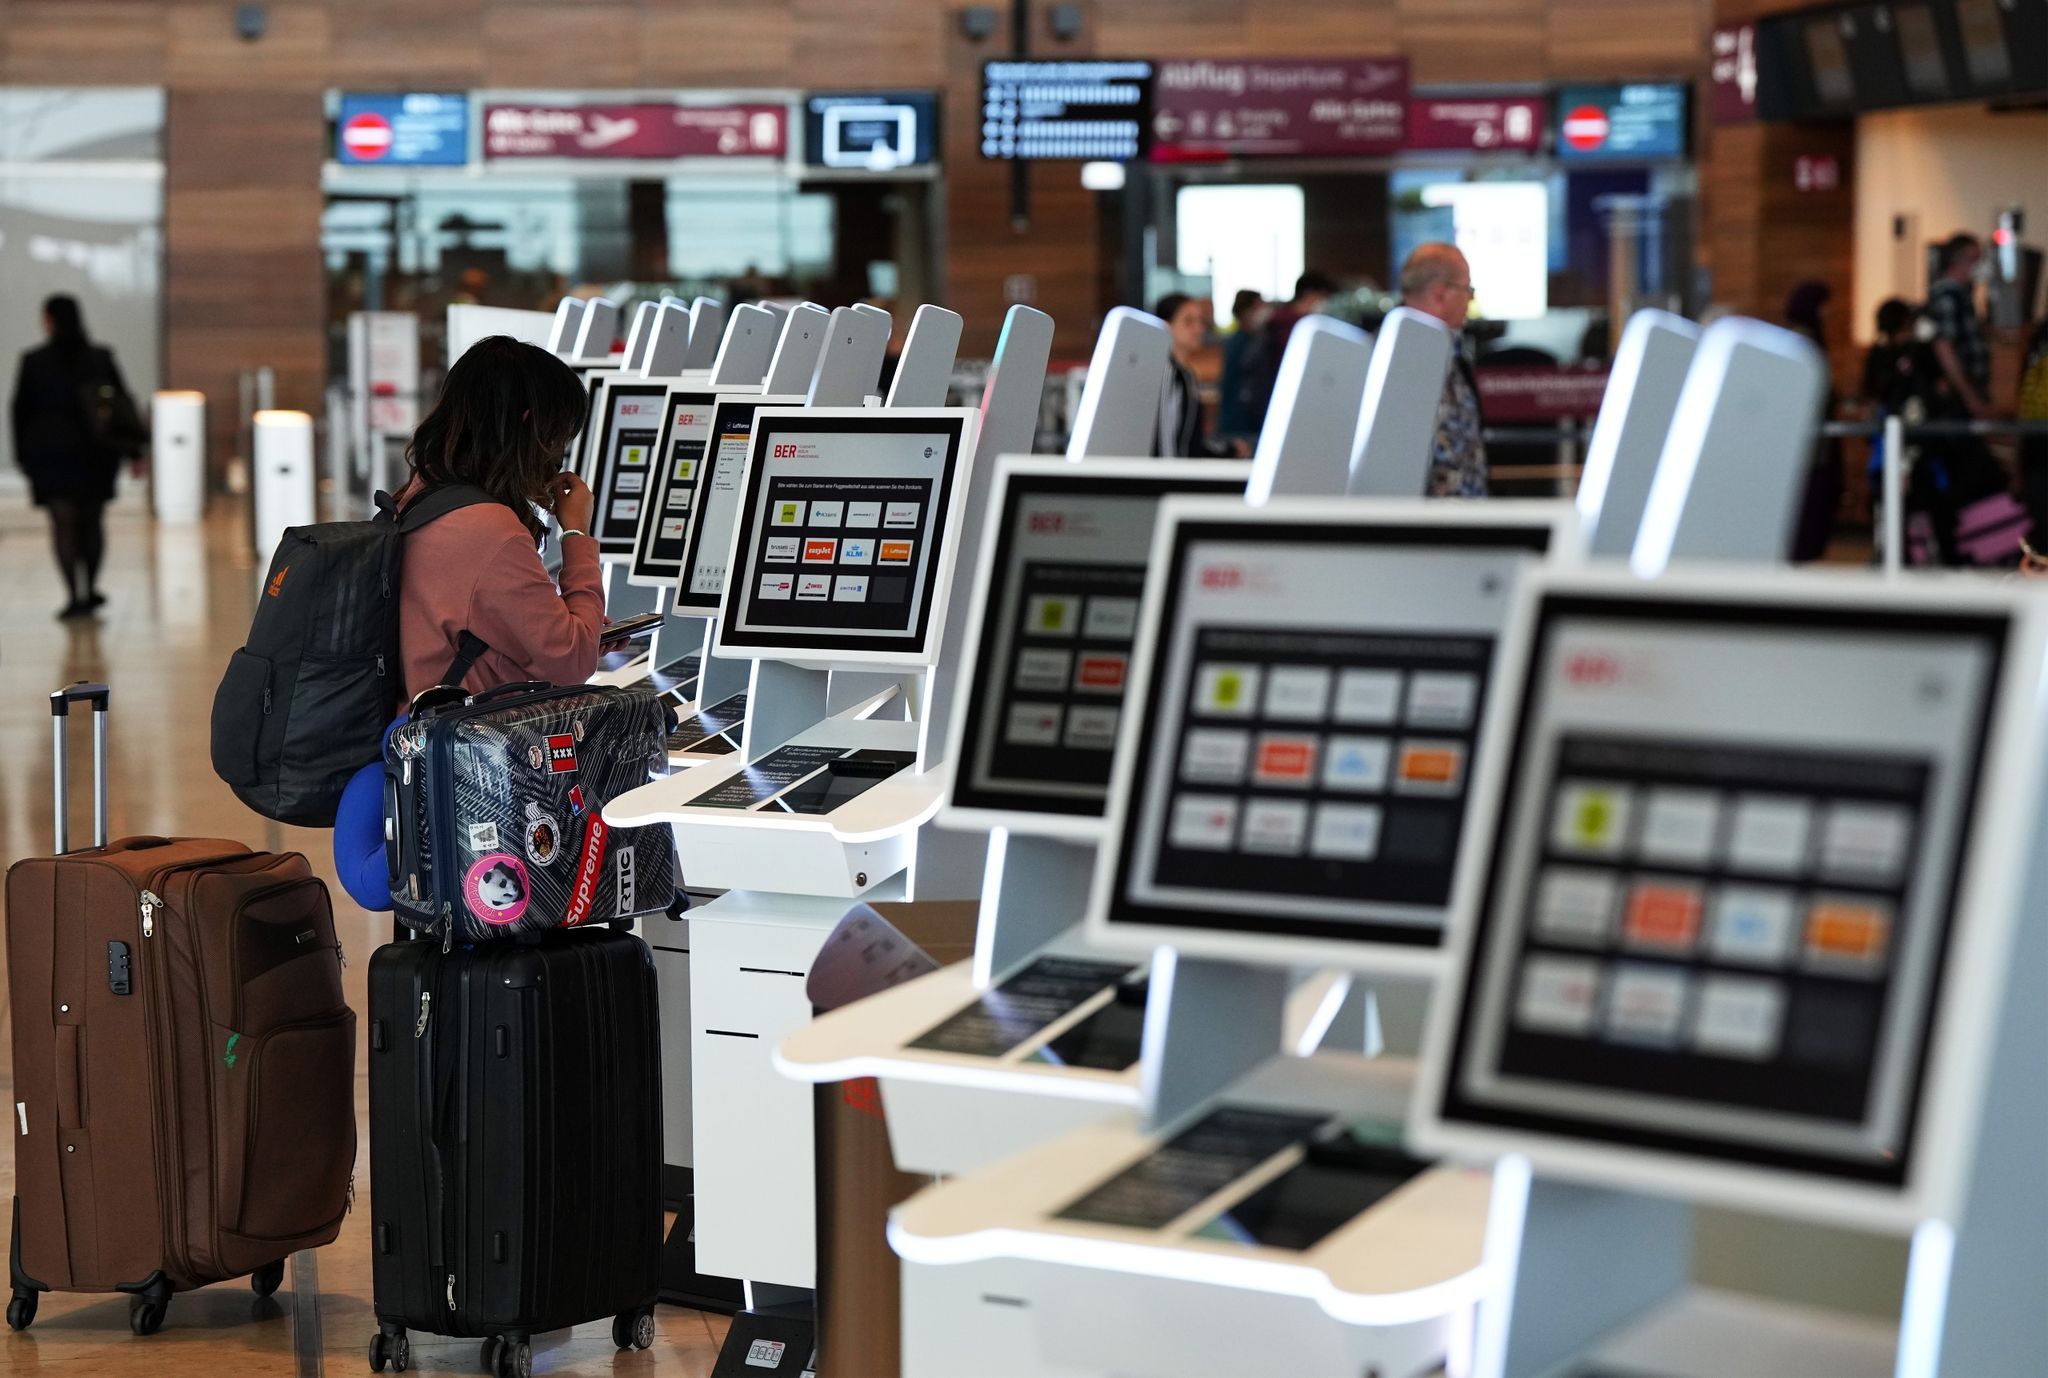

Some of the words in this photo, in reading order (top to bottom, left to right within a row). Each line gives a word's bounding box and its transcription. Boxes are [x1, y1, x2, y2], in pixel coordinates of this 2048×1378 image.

[774, 444, 797, 459] BER
[809, 547, 831, 556] easyJet
[544, 738, 554, 772] AMSTERDAM
[567, 822, 602, 926] Supreme
